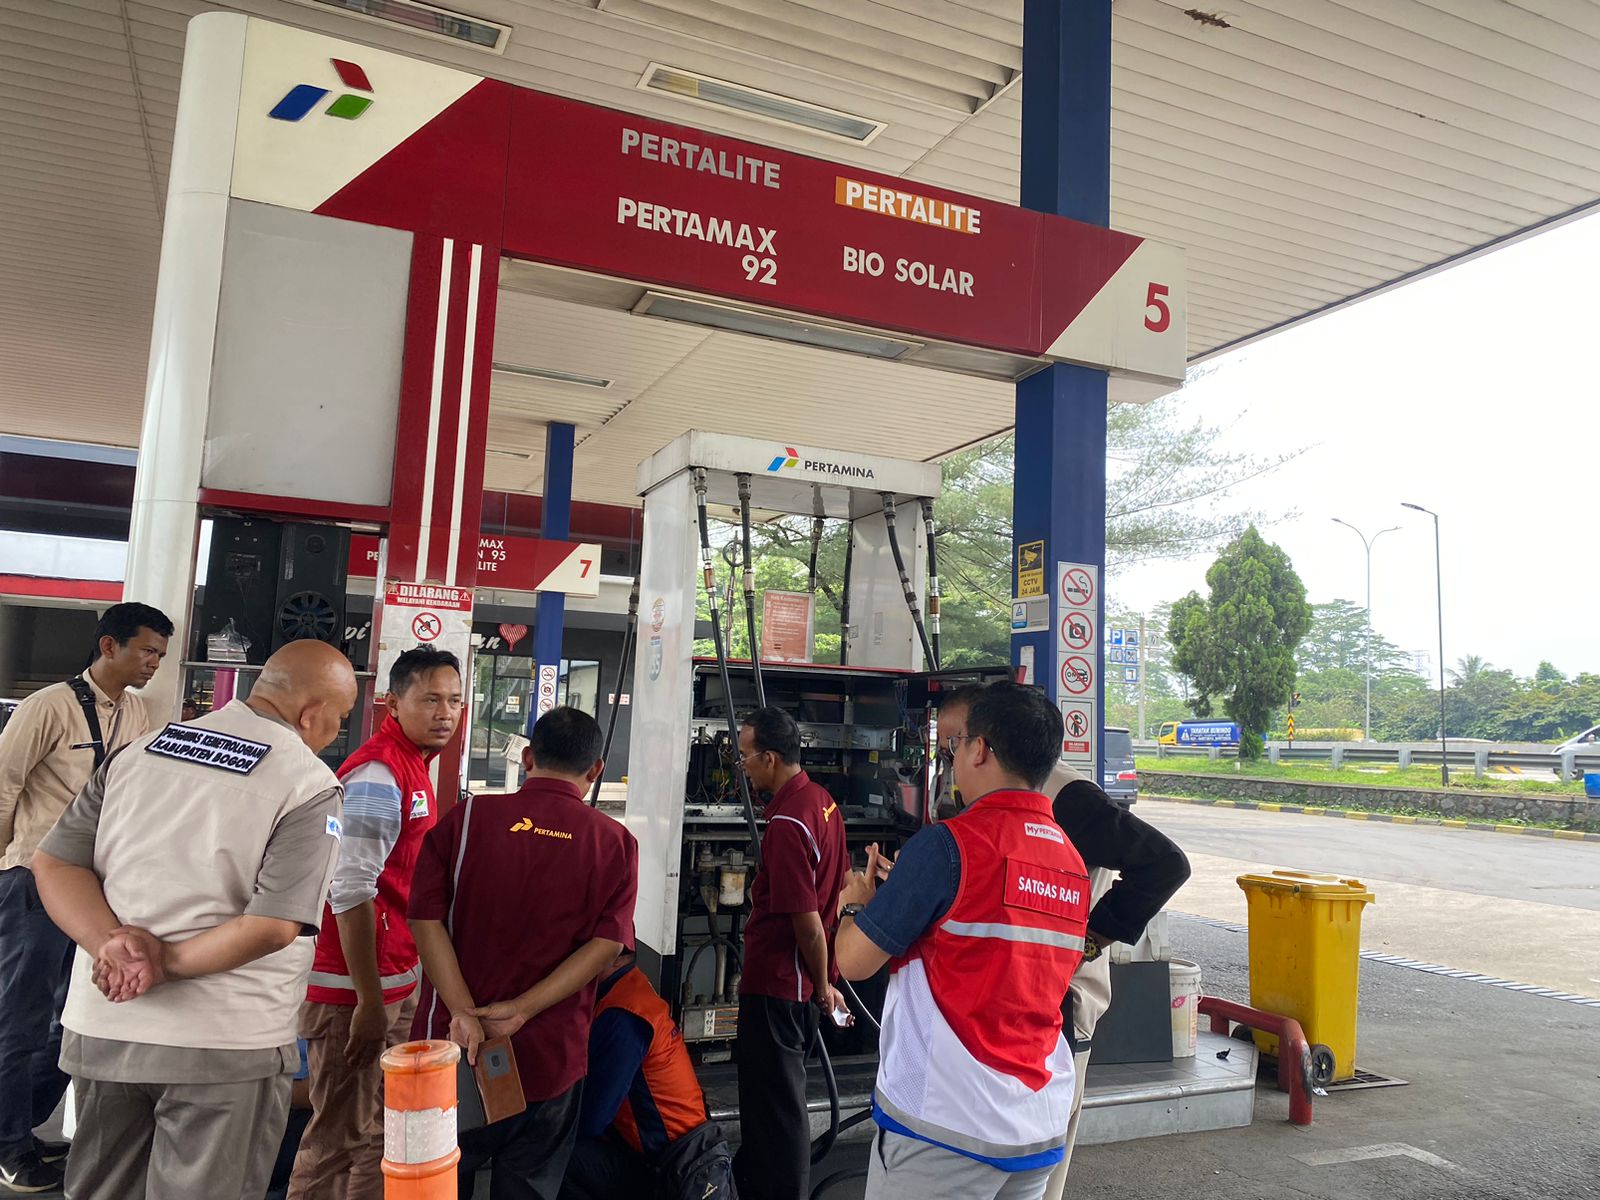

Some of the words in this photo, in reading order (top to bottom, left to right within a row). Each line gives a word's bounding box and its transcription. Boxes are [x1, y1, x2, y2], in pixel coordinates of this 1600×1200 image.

[621, 128, 781, 189] PERTALITE
[846, 180, 981, 234] PERTALITE
[617, 196, 777, 255] PERTAMAX
[741, 254, 778, 285] 92
[843, 245, 885, 277] BIO
[894, 258, 974, 297] SOLAR
[1143, 282, 1171, 333] 5
[804, 460, 875, 479] PERTAMINA
[491, 550, 506, 561] 95
[579, 559, 593, 579] 7
[400, 585, 459, 600] DILARANG
[1023, 578, 1038, 586] CCTV
[153, 739, 213, 761] KABUPATEN
[211, 752, 253, 770] BOGOR
[533, 827, 573, 840] PERTAMINA
[1018, 876, 1058, 899] SATGAS
[1059, 886, 1080, 905] RAFI
